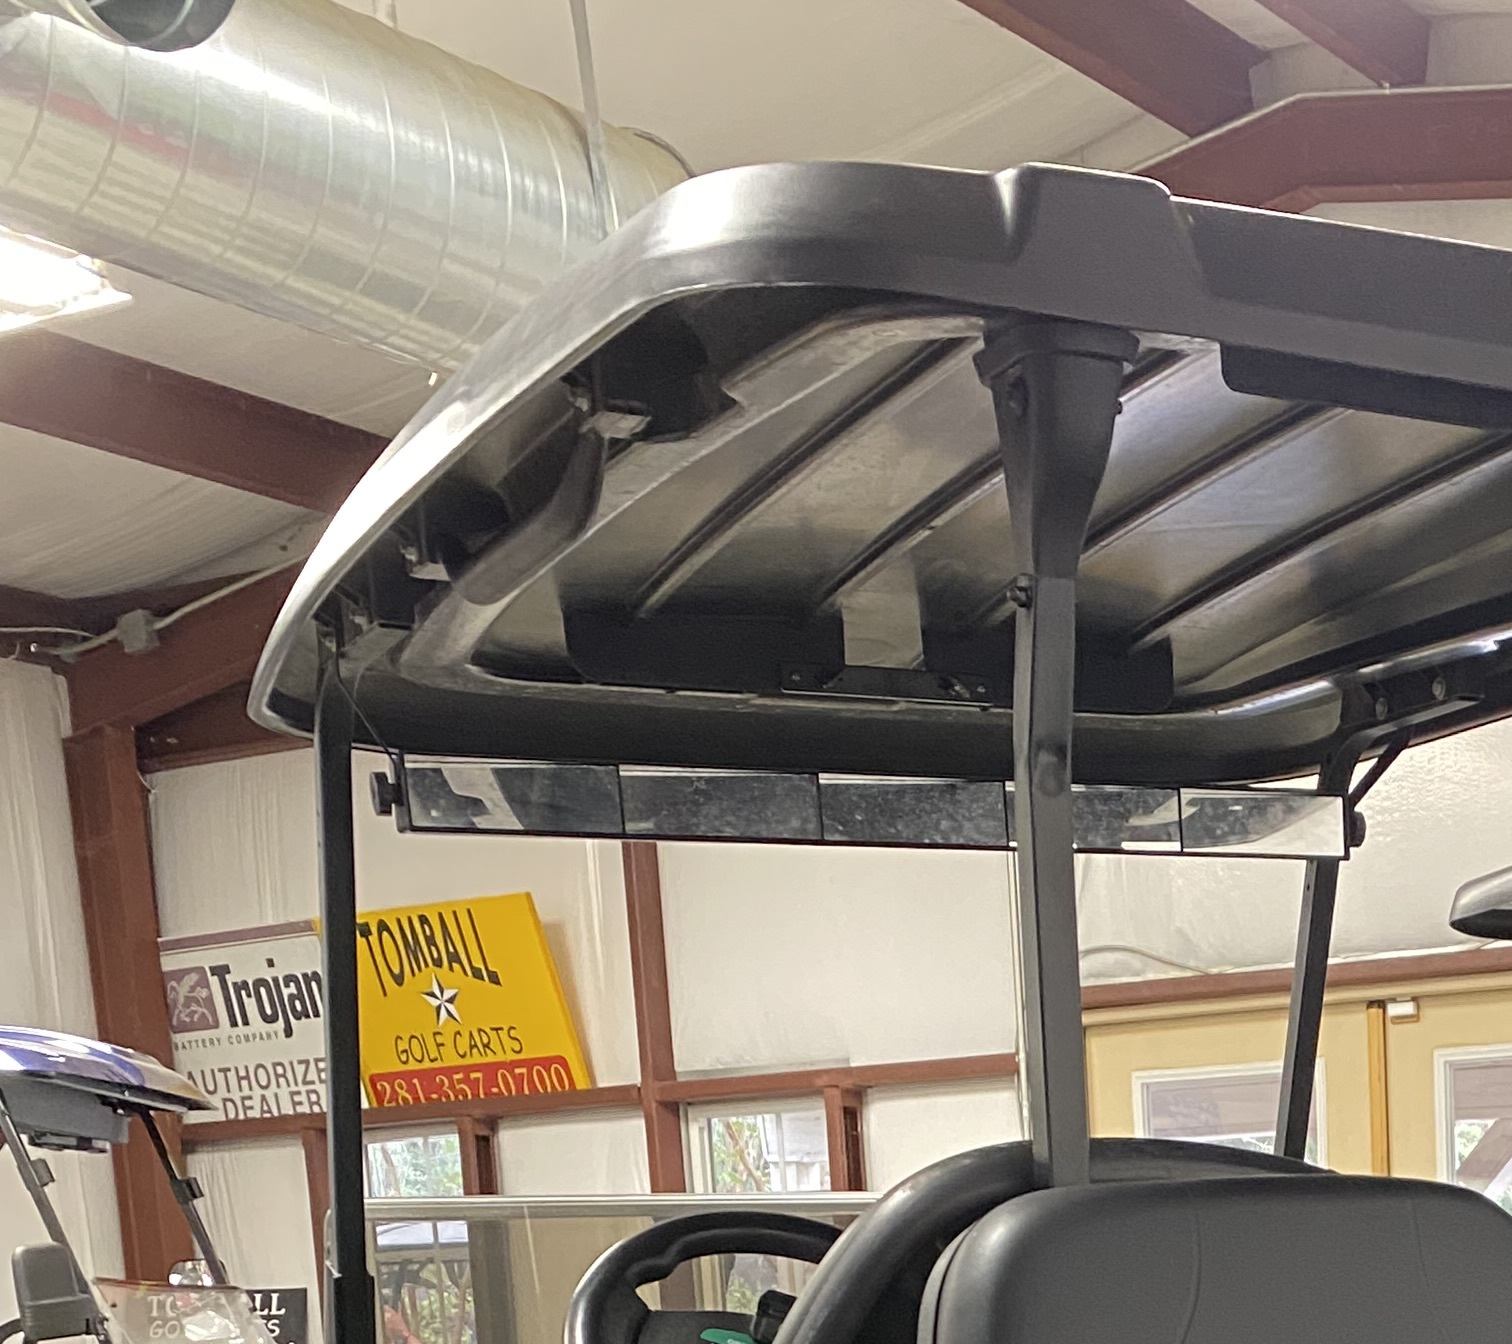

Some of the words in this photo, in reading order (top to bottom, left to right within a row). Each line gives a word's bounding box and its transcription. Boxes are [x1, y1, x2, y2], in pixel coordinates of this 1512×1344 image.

[357, 908, 502, 997] TOMBALL
[209, 958, 322, 1038] Trojan
[174, 1037, 222, 1052] BATTERY
[228, 1030, 280, 1045] COMPANY
[395, 1031, 446, 1065] GOLF
[453, 1026, 524, 1059] CARTS
[187, 1057, 327, 1096] AUTHORIZE
[377, 1064, 569, 1107] 281-357-0700
[222, 1089, 325, 1119] DEALER
